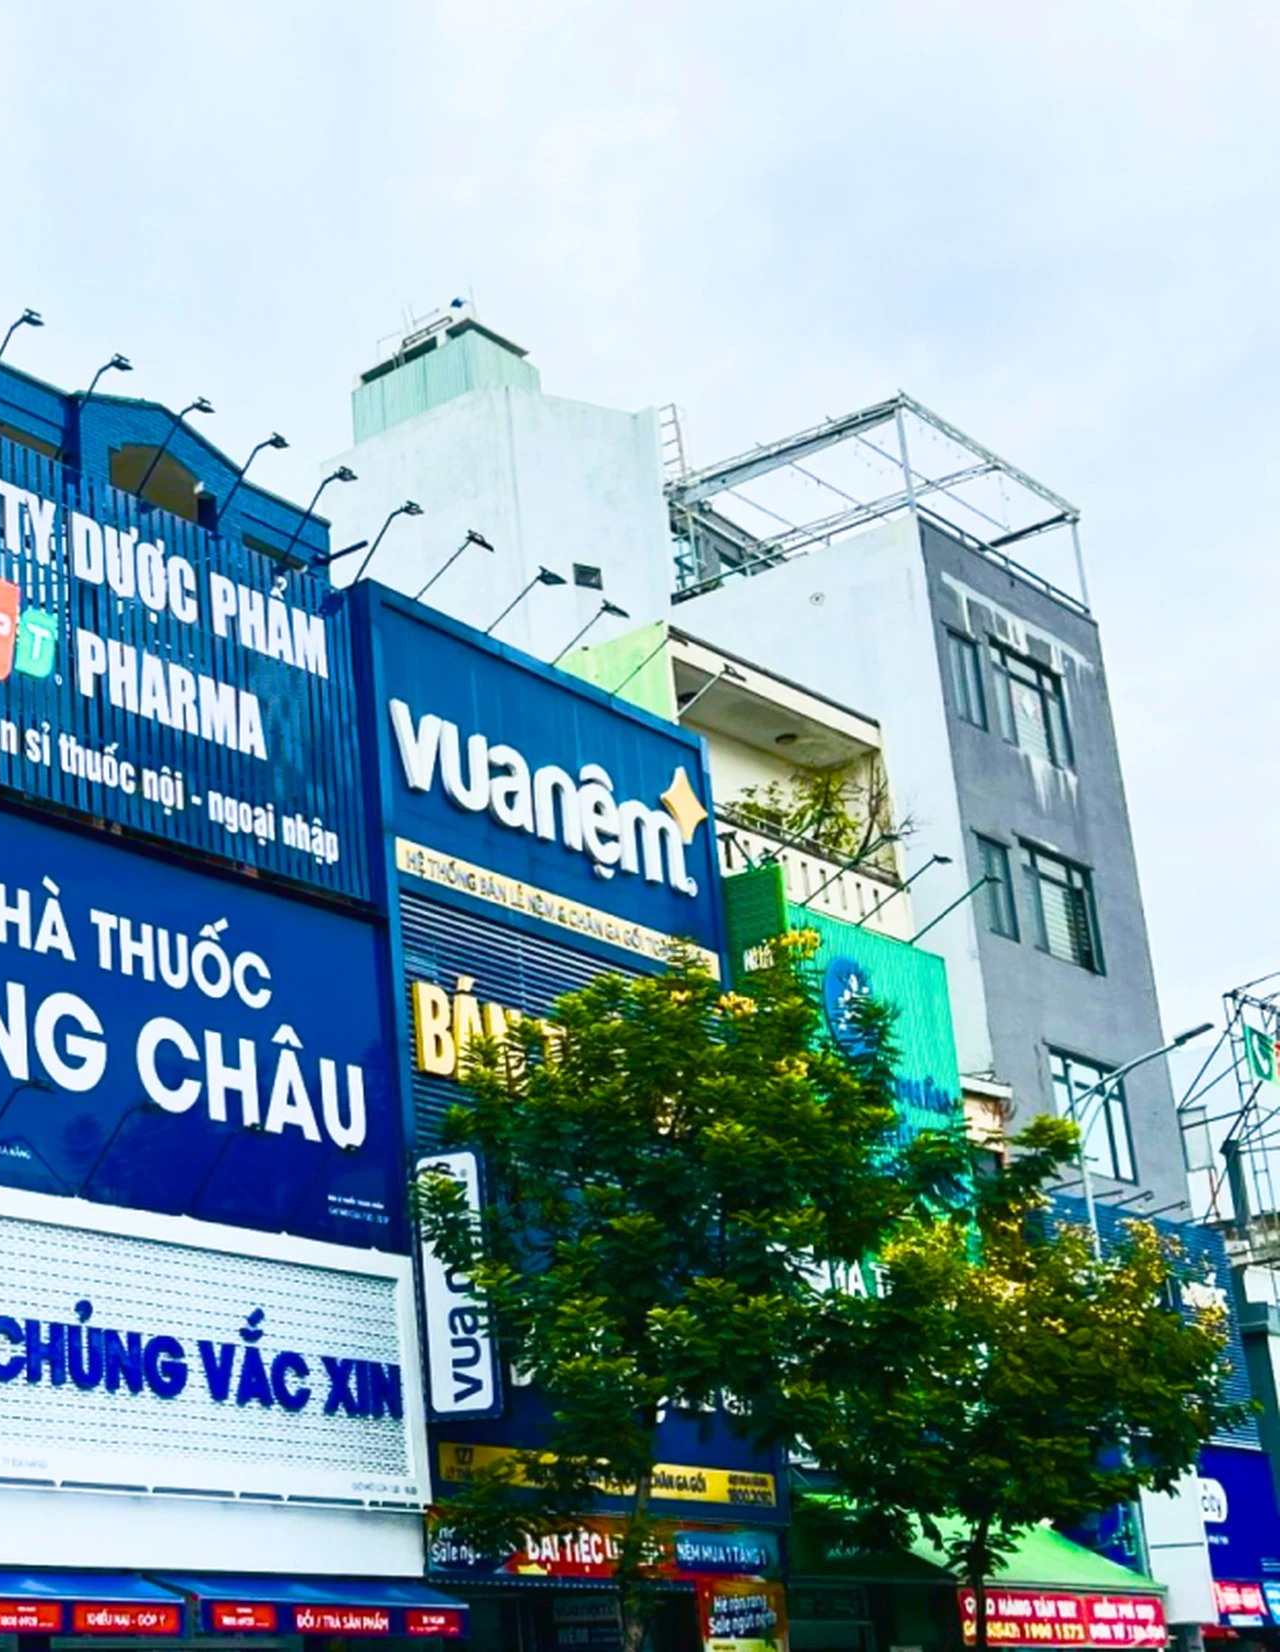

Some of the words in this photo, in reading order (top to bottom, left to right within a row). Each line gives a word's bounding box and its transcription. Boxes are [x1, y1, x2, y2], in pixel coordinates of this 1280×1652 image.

[71, 508, 199, 626] DƯỢC
[210, 577, 331, 679] PHẨM
[76, 627, 268, 760] PHARMA
[24, 720, 52, 766] sỉ
[58, 731, 136, 796] thuốc
[142, 762, 185, 817] nội
[207, 784, 275, 847] ngoại
[281, 811, 340, 866] nhập
[427, 858, 476, 891] THỐNG
[480, 875, 507, 903] BÁN
[90, 907, 273, 1010] THUỐC
[135, 1015, 367, 1150] CHÂU
[199, 1307, 312, 1411] VẮC
[323, 1355, 405, 1419] XIN
